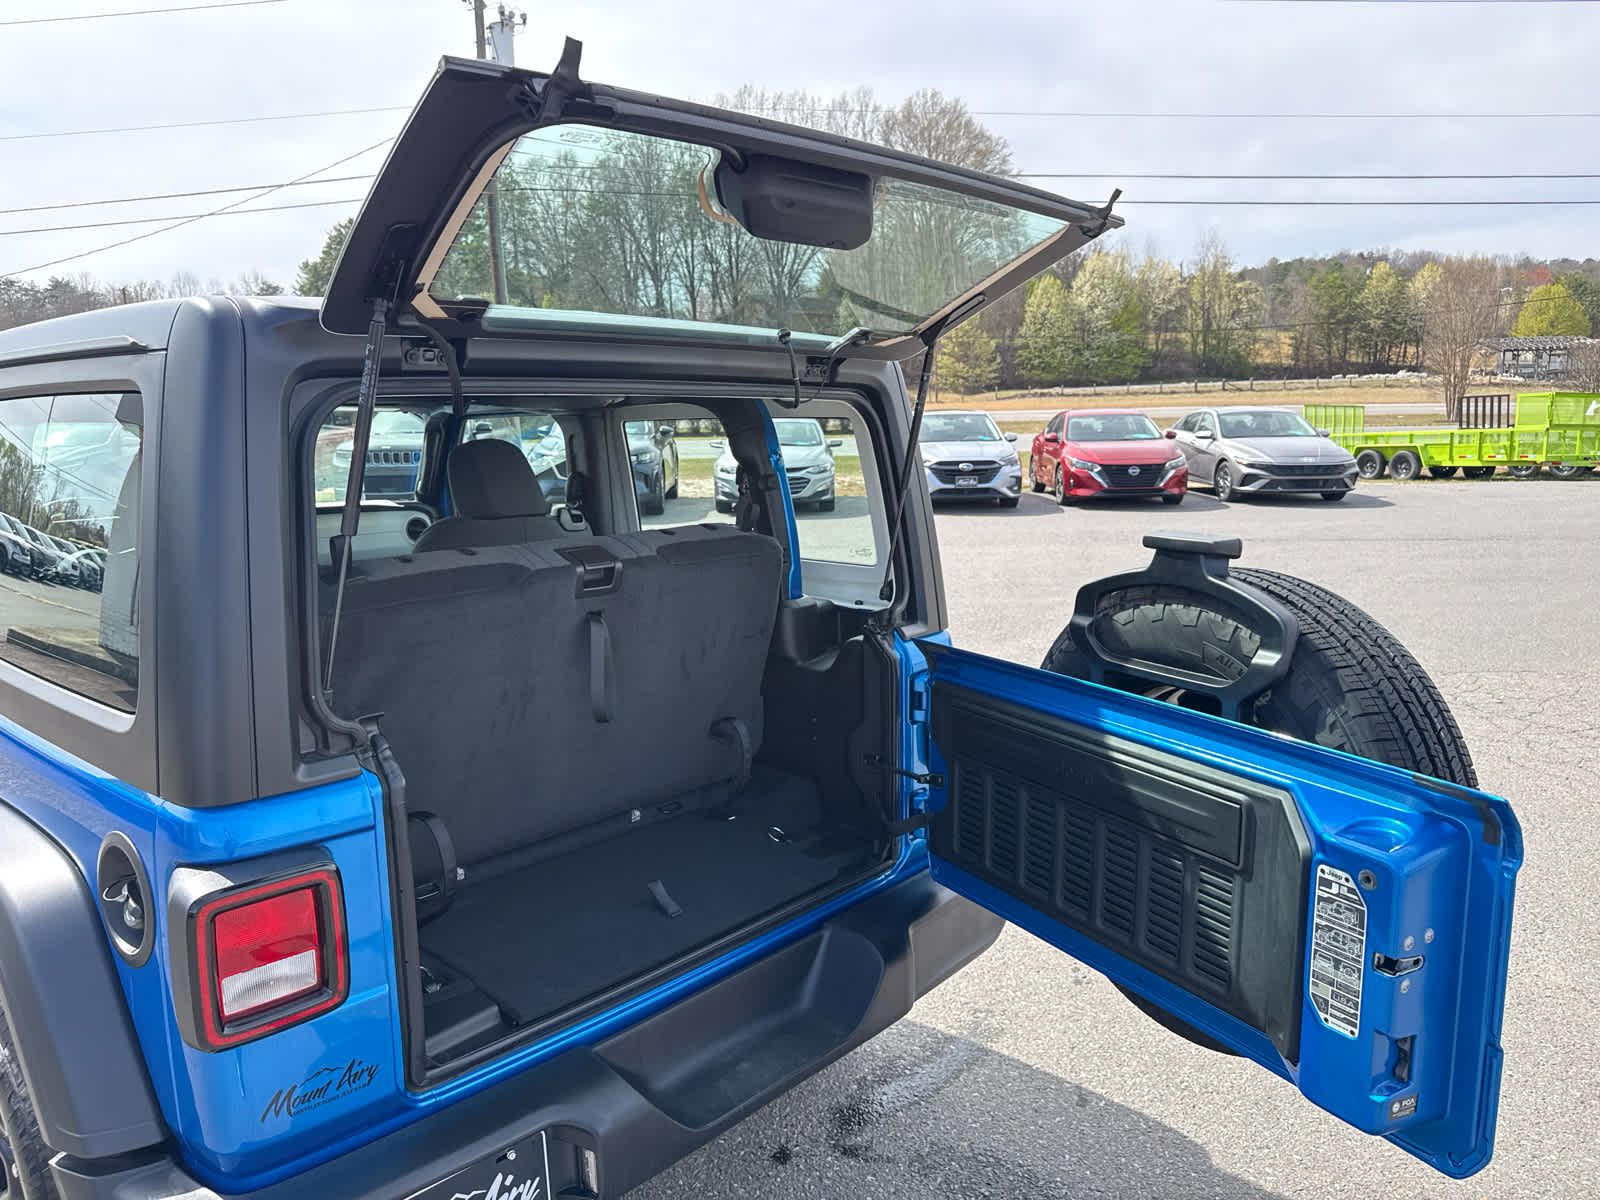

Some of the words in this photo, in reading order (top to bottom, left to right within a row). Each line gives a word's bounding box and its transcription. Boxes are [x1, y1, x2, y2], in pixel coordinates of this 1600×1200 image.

[1326, 870, 1343, 880] Jeep
[260, 1083, 333, 1123] Mount
[336, 1059, 379, 1088] Airy
